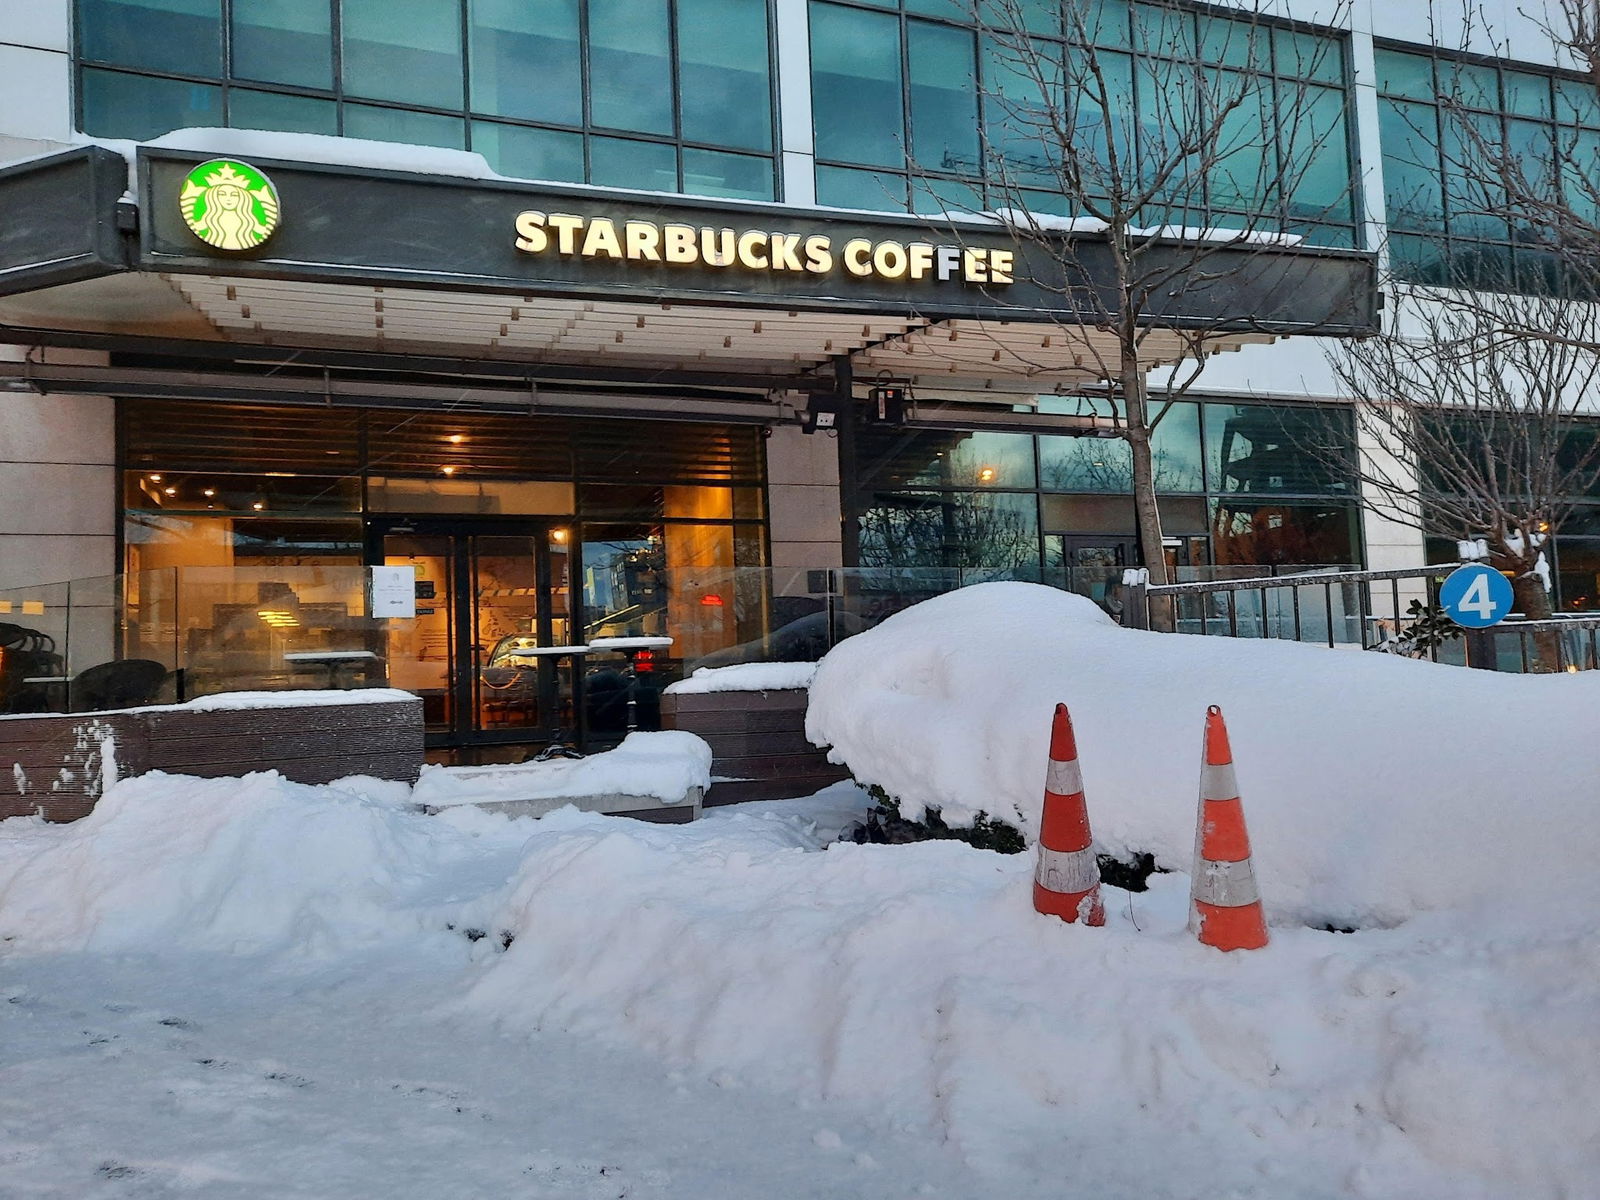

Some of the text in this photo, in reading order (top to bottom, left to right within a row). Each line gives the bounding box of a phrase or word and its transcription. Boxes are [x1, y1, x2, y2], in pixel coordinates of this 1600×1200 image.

[514, 210, 1014, 284] STARBUCKS COFFEE
[1458, 573, 1497, 620] 4
